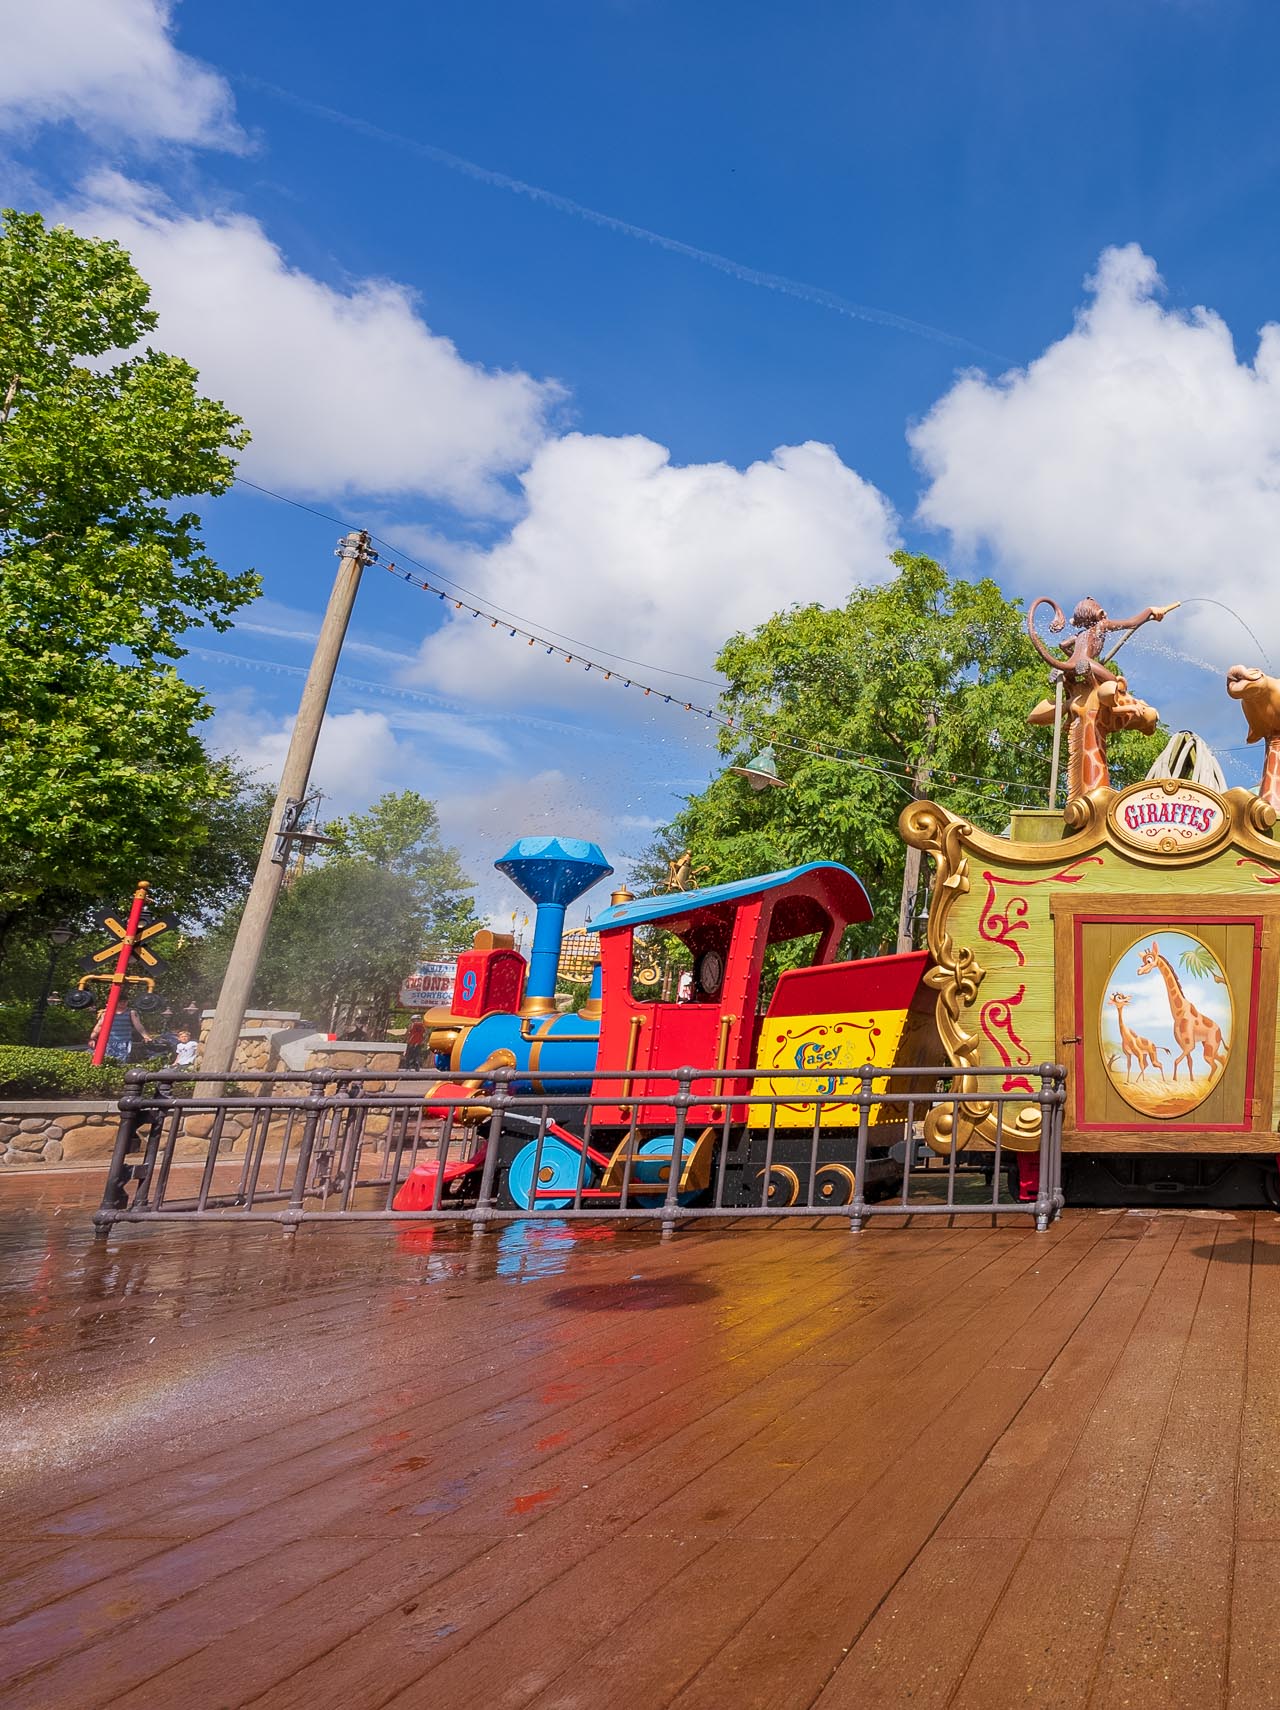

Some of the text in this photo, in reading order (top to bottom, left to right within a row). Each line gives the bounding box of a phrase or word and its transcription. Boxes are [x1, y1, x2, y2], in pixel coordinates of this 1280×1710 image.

[1124, 803, 1217, 833] GIRAFFES
[463, 971, 477, 1001] 9
[794, 1042, 842, 1070] Casey
